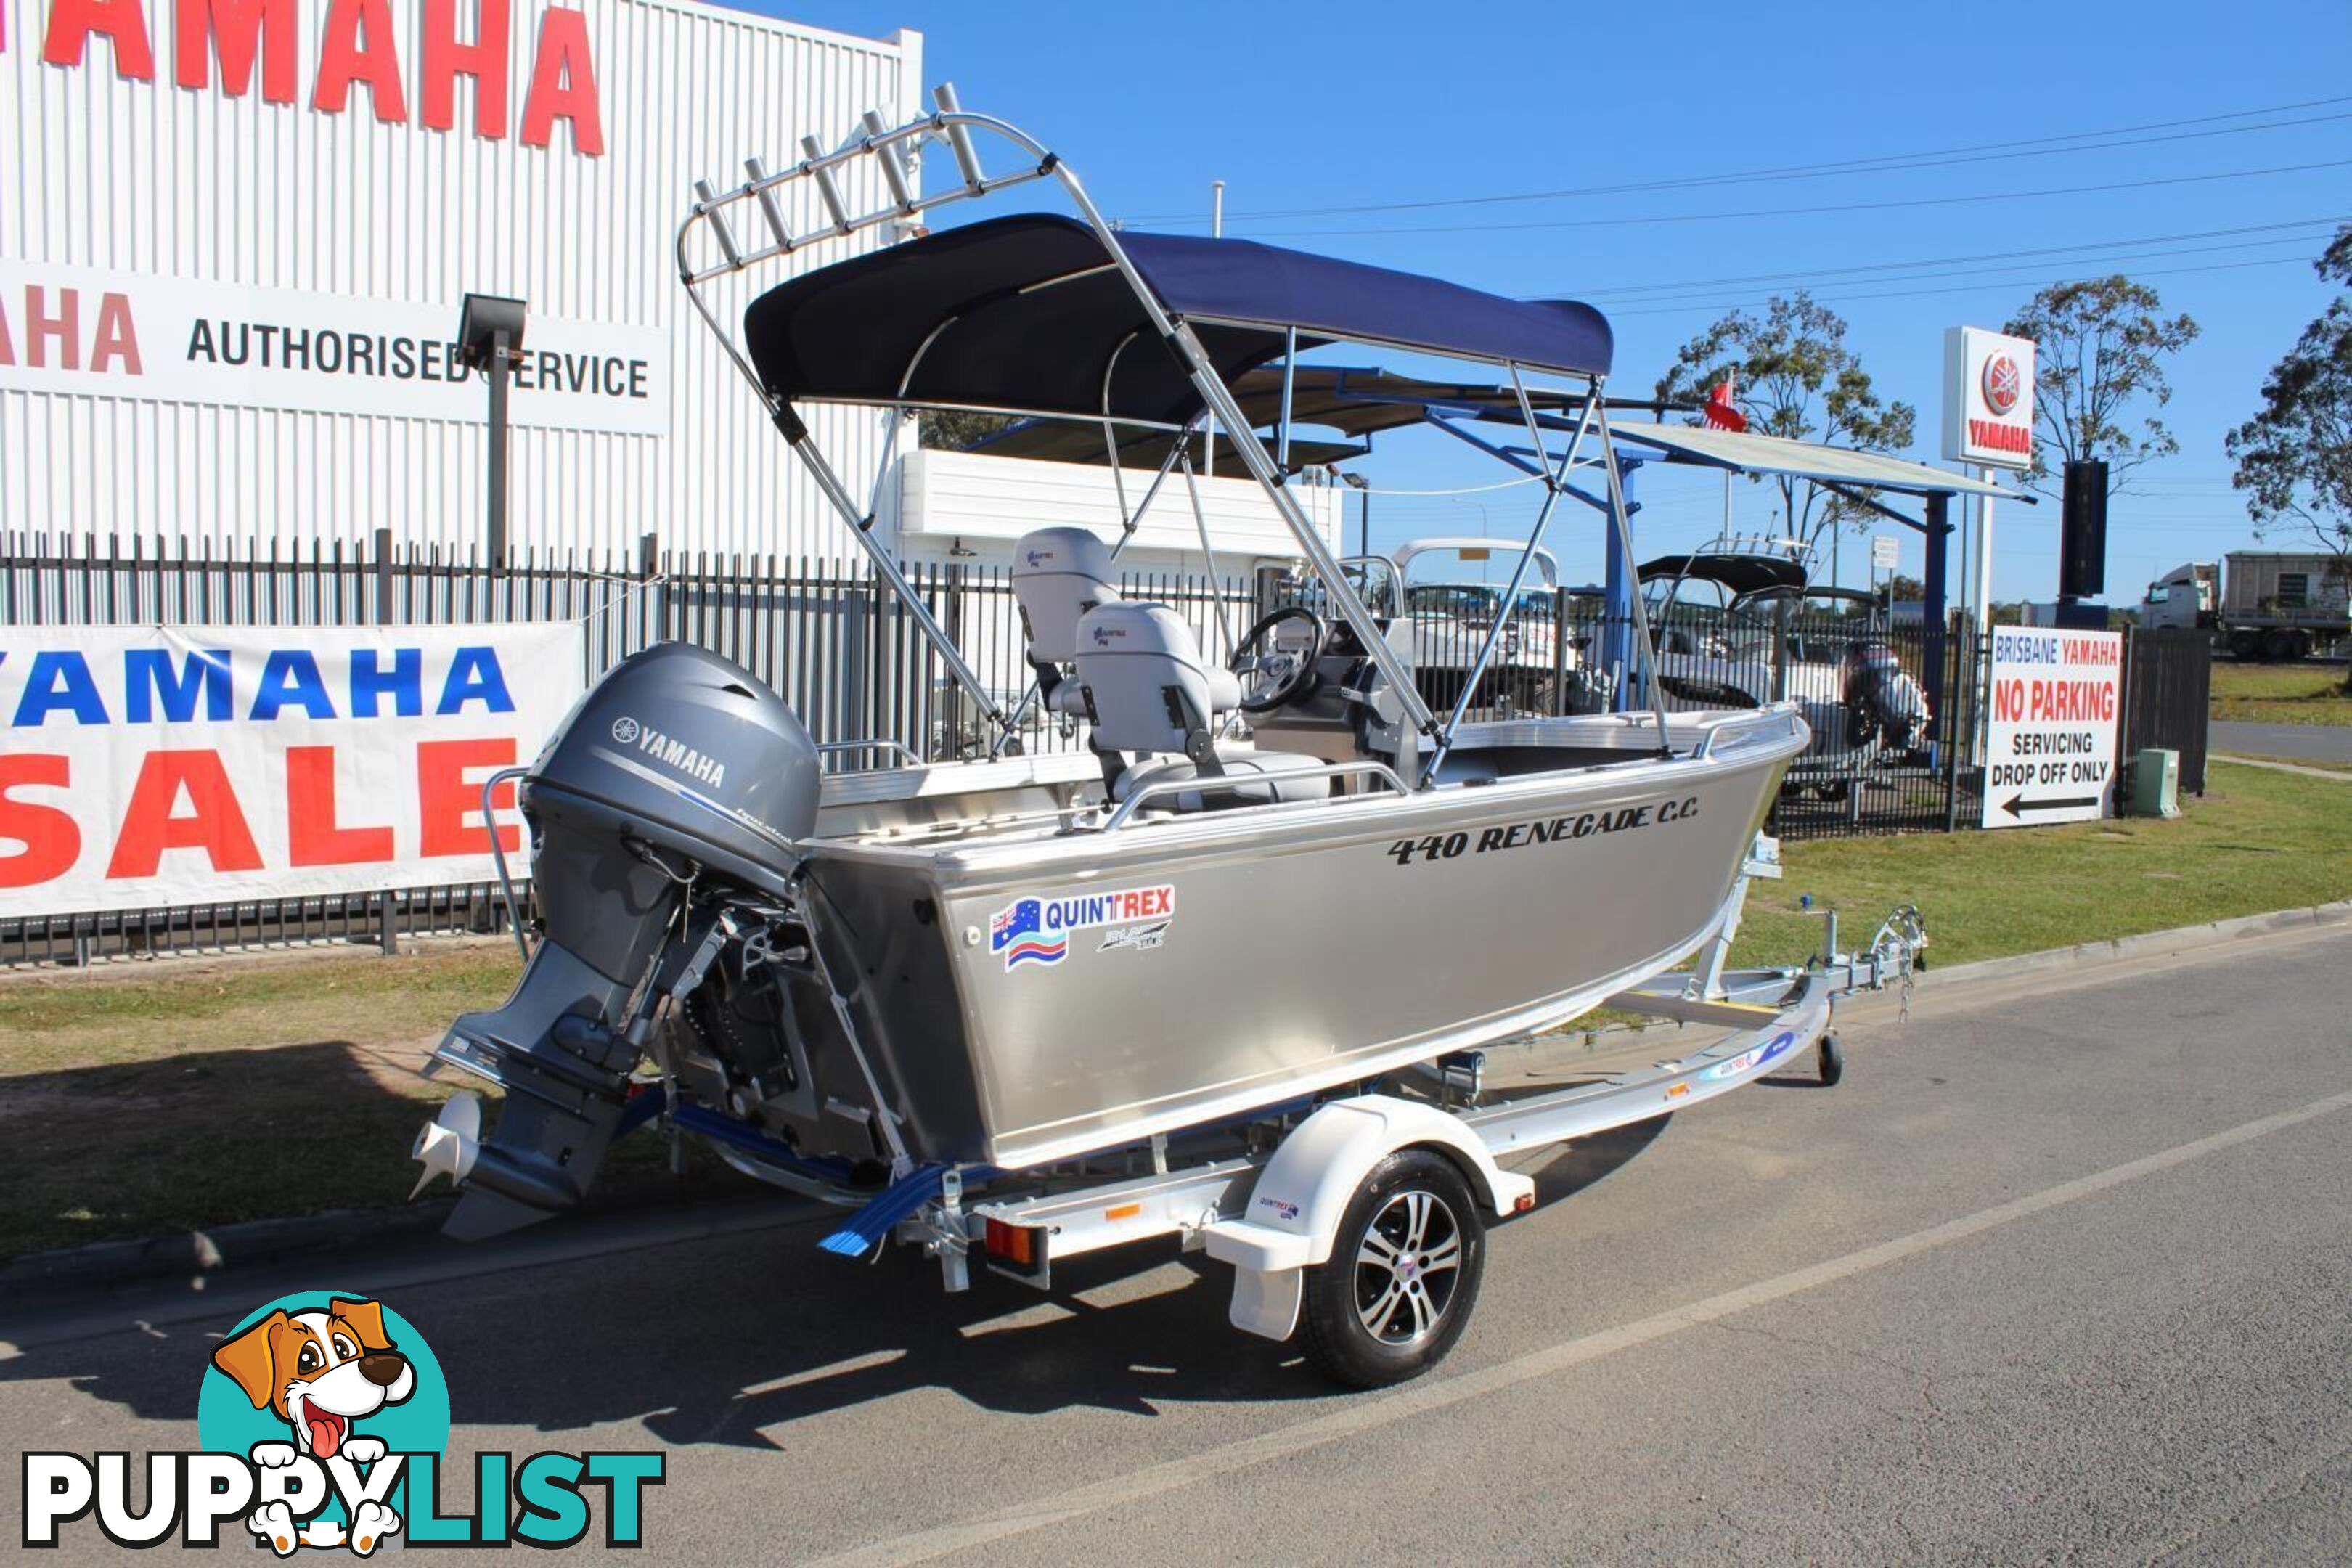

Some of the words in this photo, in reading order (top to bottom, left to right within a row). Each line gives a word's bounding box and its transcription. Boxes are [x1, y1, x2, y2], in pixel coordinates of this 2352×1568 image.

[513, 349, 649, 399] ERVICE
[1968, 419, 2030, 454] YAMAHA
[1996, 635, 2058, 664] BRISBANE
[2062, 638, 2118, 666] YAMAHA
[0, 645, 516, 727] AMAHA
[1994, 679, 2025, 722] NO
[2030, 680, 2114, 722] PARKING
[637, 727, 726, 789] YAMAHA
[2012, 732, 2093, 756] SERVICING
[1991, 764, 2035, 787] DROP
[2039, 762, 2067, 784] OFF
[2070, 761, 2108, 783] ONLY
[0, 737, 521, 889] SALE
[1387, 832, 1469, 865] 440
[1475, 804, 1654, 853] RENEGADE
[1045, 887, 1172, 930] QUINTREX
